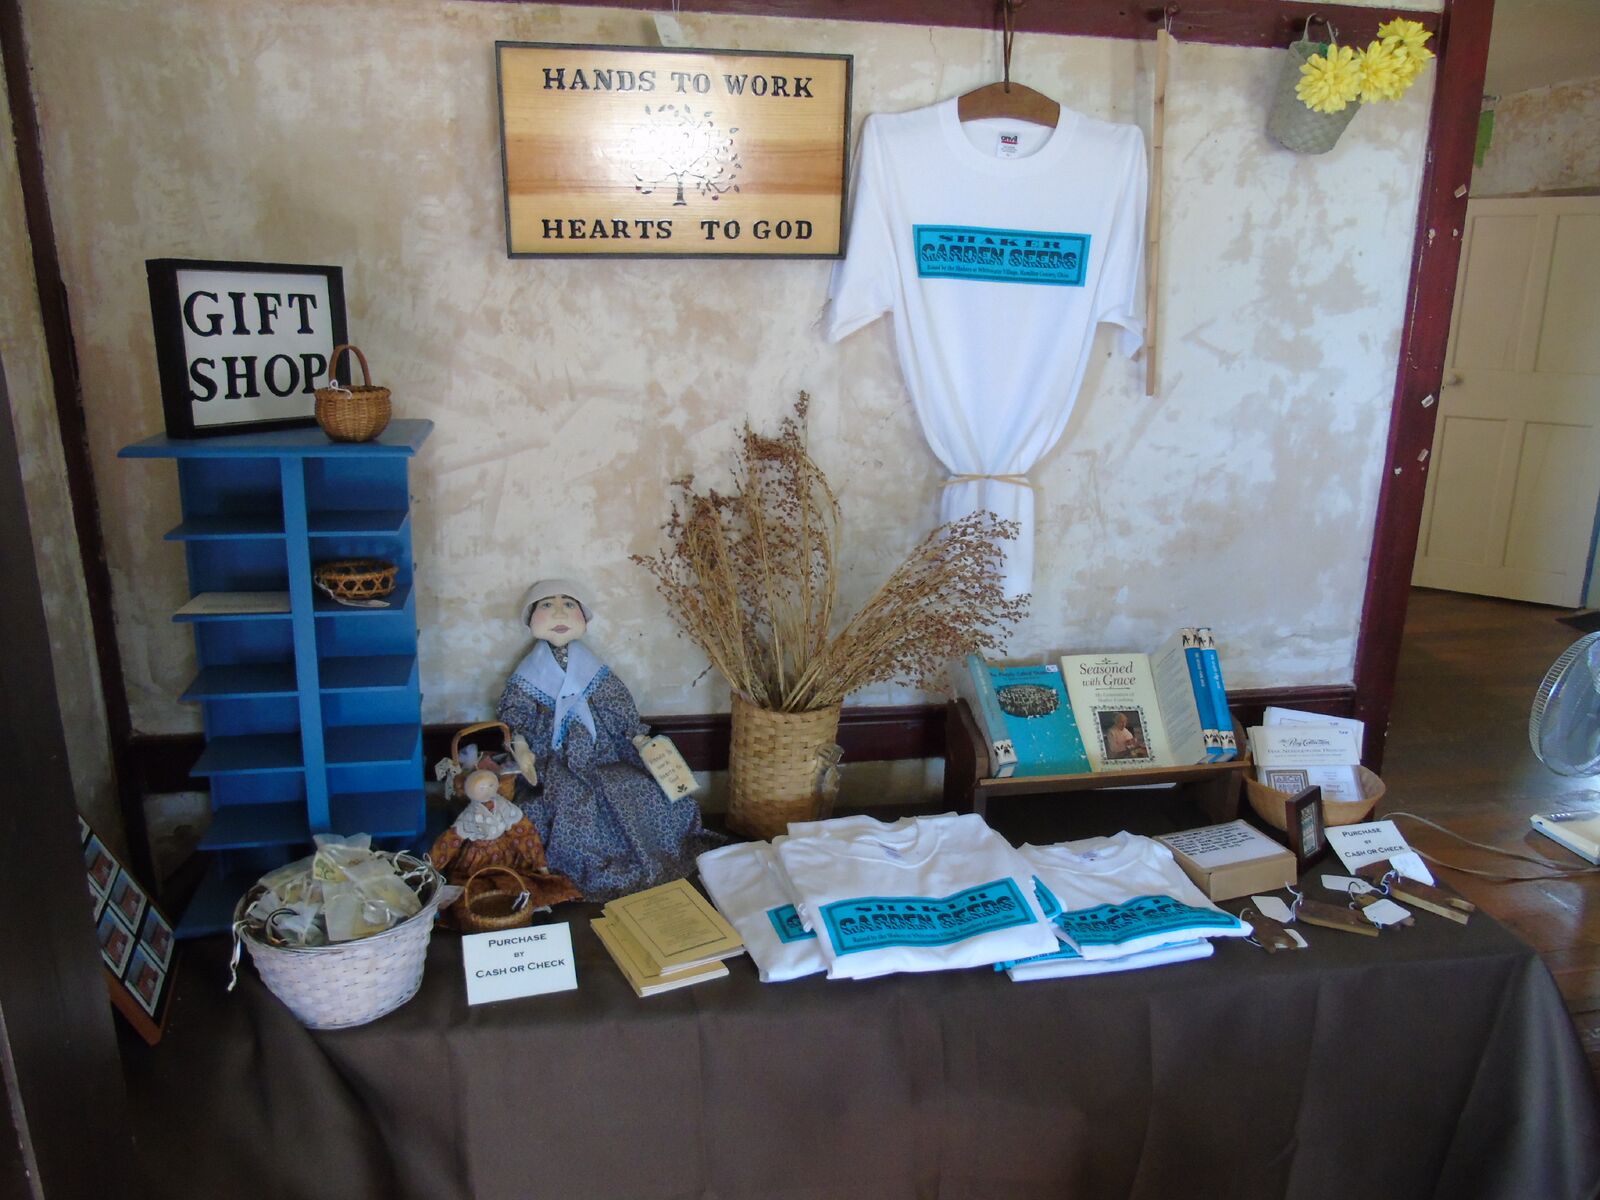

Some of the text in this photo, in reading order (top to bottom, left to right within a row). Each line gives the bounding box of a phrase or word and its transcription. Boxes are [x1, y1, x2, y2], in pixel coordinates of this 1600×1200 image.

[542, 68, 814, 98] HANDS TO WORK
[542, 218, 813, 240] HEARTS TO GOD
[939, 235, 1060, 248] SHAKER
[921, 243, 1077, 270] GARDEN SEEDS
[183, 290, 318, 337] GIFT
[189, 353, 327, 402] SHOP
[1079, 661, 1133, 675] Seasoned
[1082, 674, 1136, 687] with Grace
[1341, 828, 1382, 837] PURCHASE
[1378, 845, 1404, 854] CHECK
[839, 913, 937, 936] GARDEN
[937, 895, 1016, 929] SEEDS
[488, 933, 547, 947] PURCHASE
[475, 959, 565, 979] CASH OR CHECK
